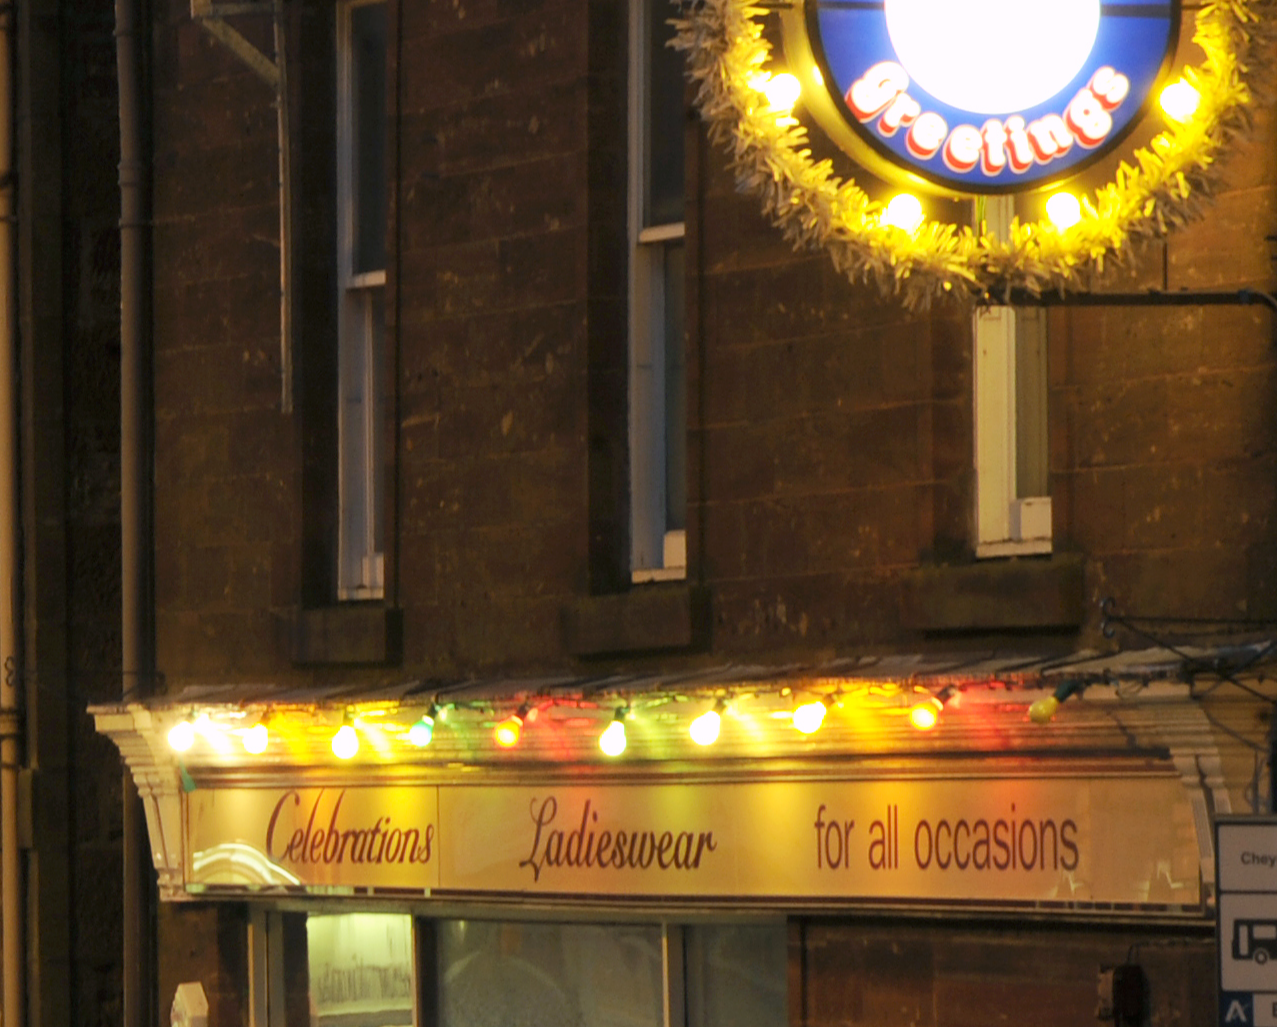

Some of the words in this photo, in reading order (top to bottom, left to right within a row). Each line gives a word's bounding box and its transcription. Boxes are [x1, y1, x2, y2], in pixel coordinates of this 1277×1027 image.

[845, 60, 1131, 177] Greetings
[265, 788, 435, 865] Celebrations
[519, 795, 718, 883] Ladieswear
[813, 804, 856, 871] for
[867, 804, 899, 871] all
[913, 804, 1081, 872] occasions
